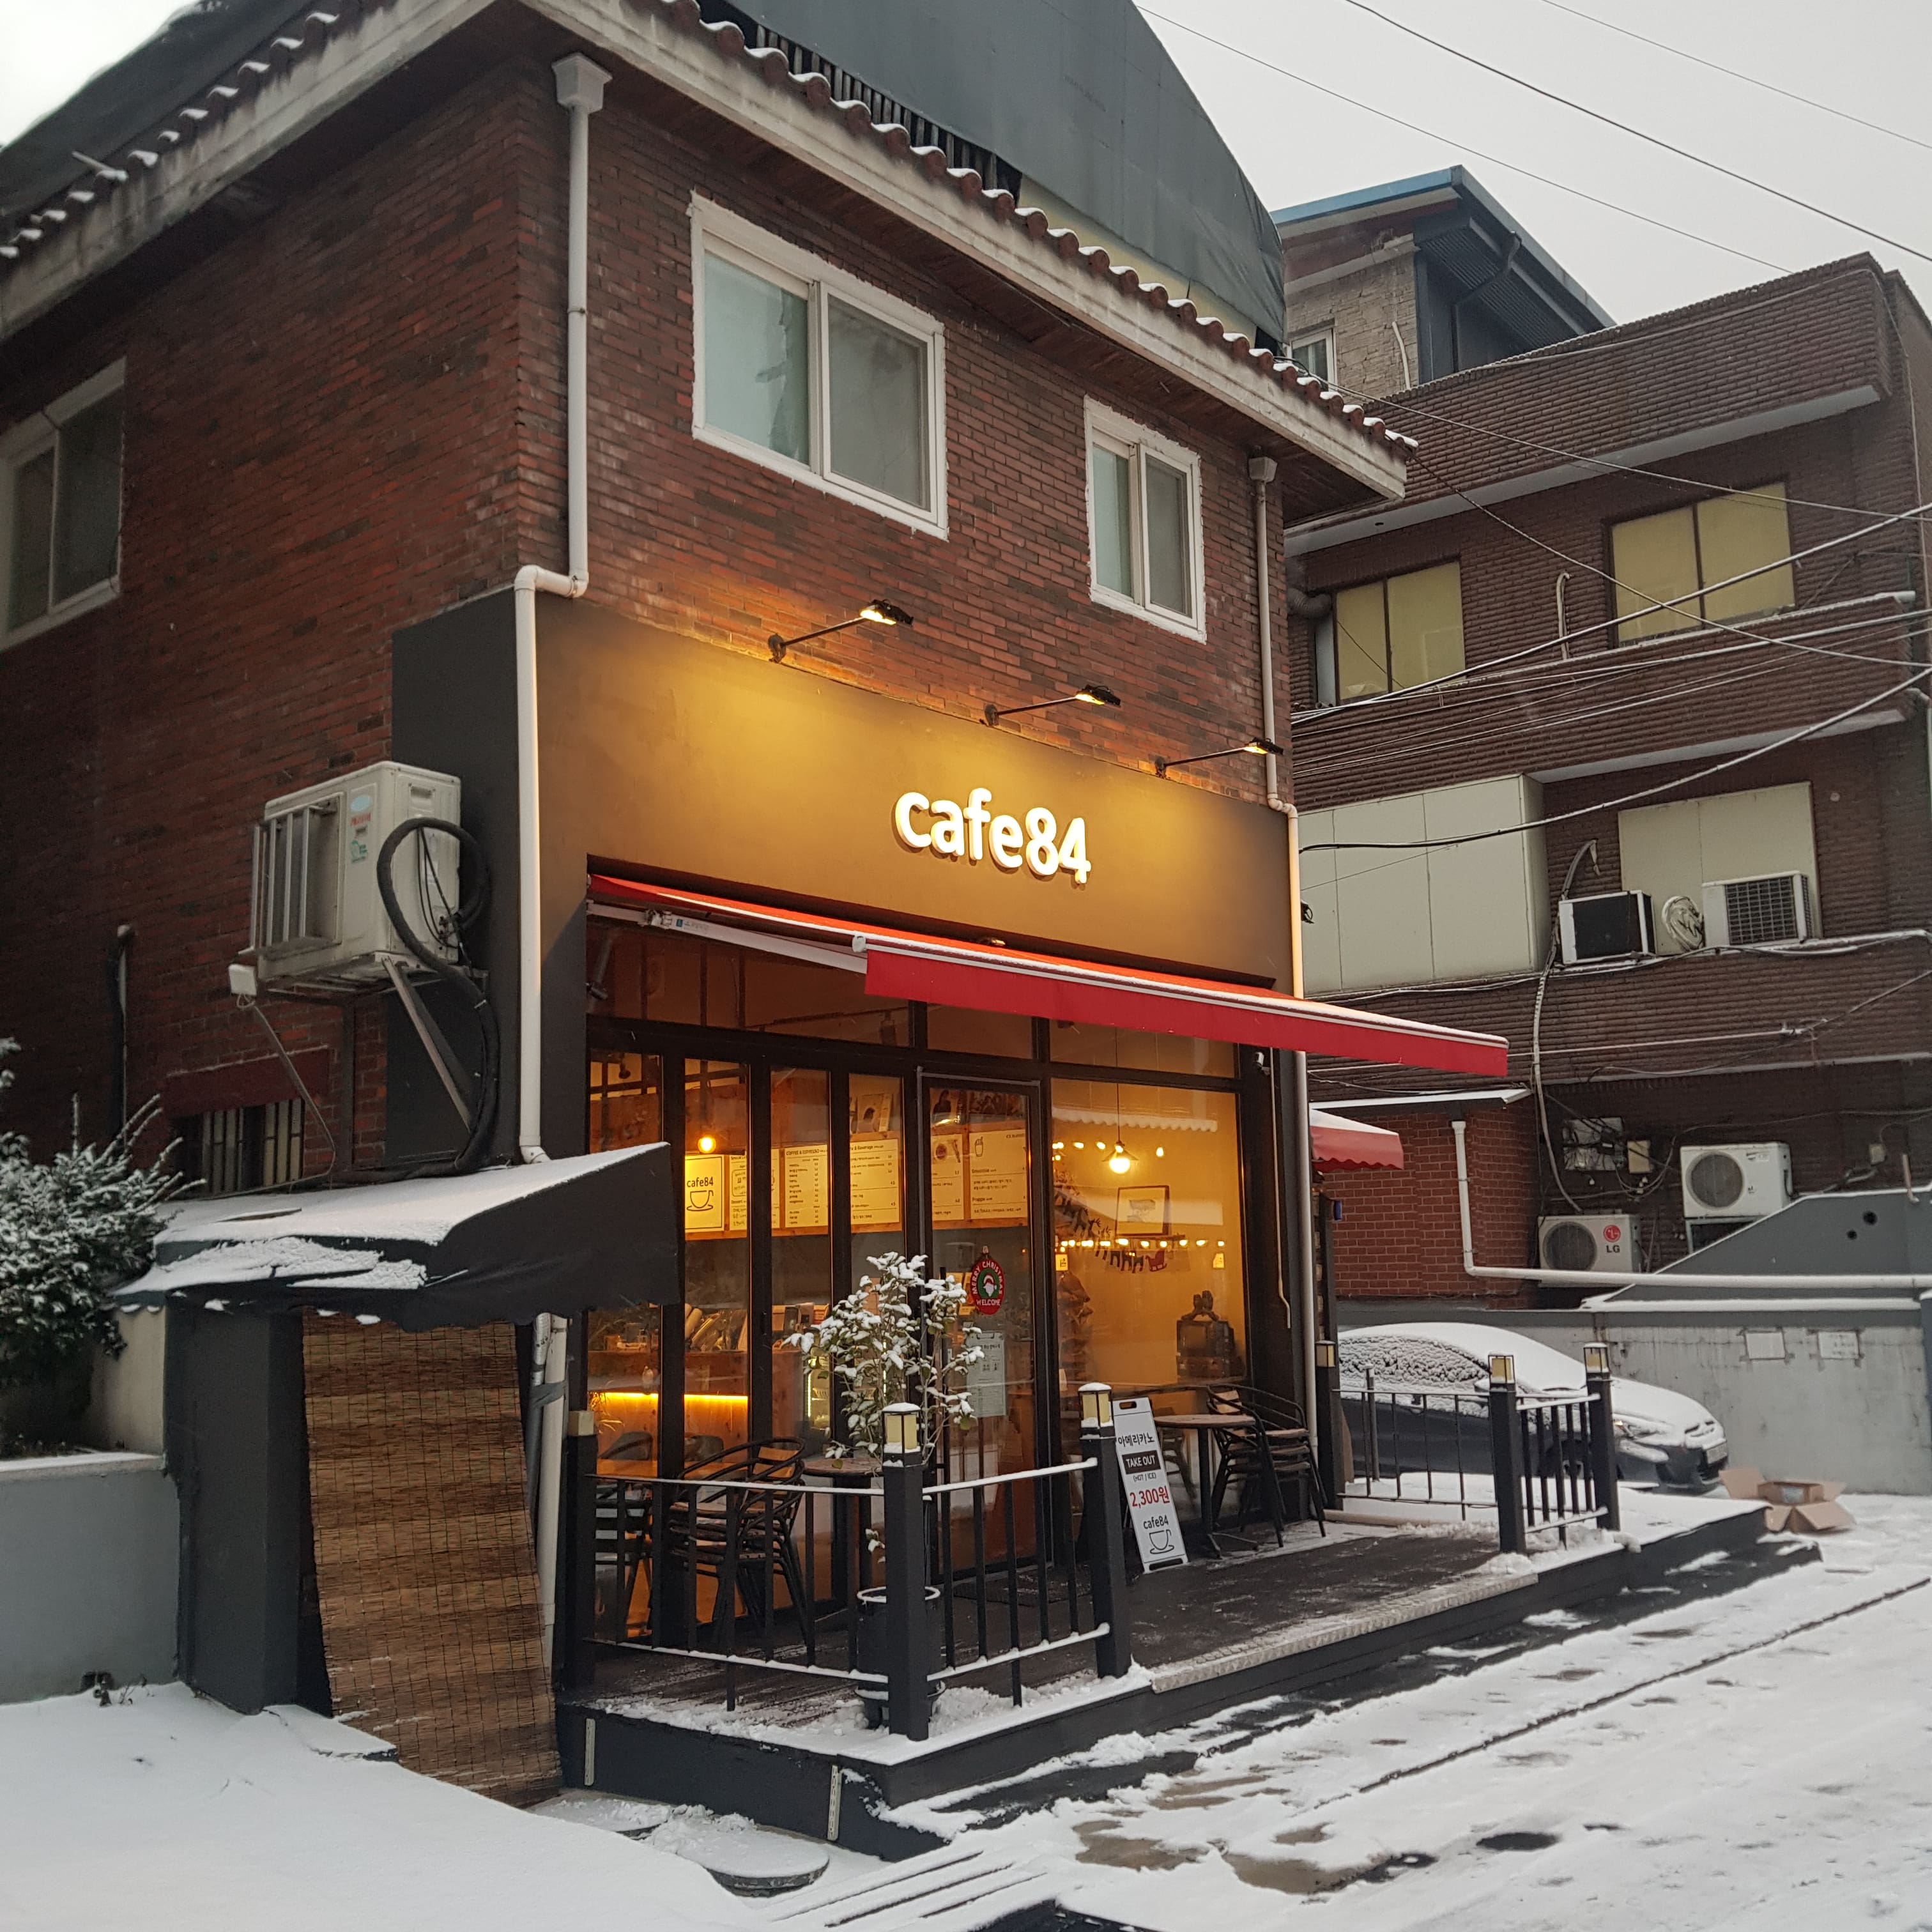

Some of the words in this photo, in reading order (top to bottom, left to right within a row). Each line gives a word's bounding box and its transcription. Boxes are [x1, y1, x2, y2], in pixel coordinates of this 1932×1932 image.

[894, 787, 1092, 884] cafe84
[686, 1176, 714, 1188] cafe84
[1606, 1245, 1620, 1253] LG
[972, 1266, 981, 1294] MERRY
[982, 1261, 1003, 1294] CHRISTMAS
[1118, 1432, 1154, 1447] 아메리카노
[1126, 1457, 1142, 1468] TAKE
[1143, 1455, 1155, 1465] OUT
[1130, 1485, 1170, 1508] 2,300원
[1143, 1514, 1169, 1529] cafe84
